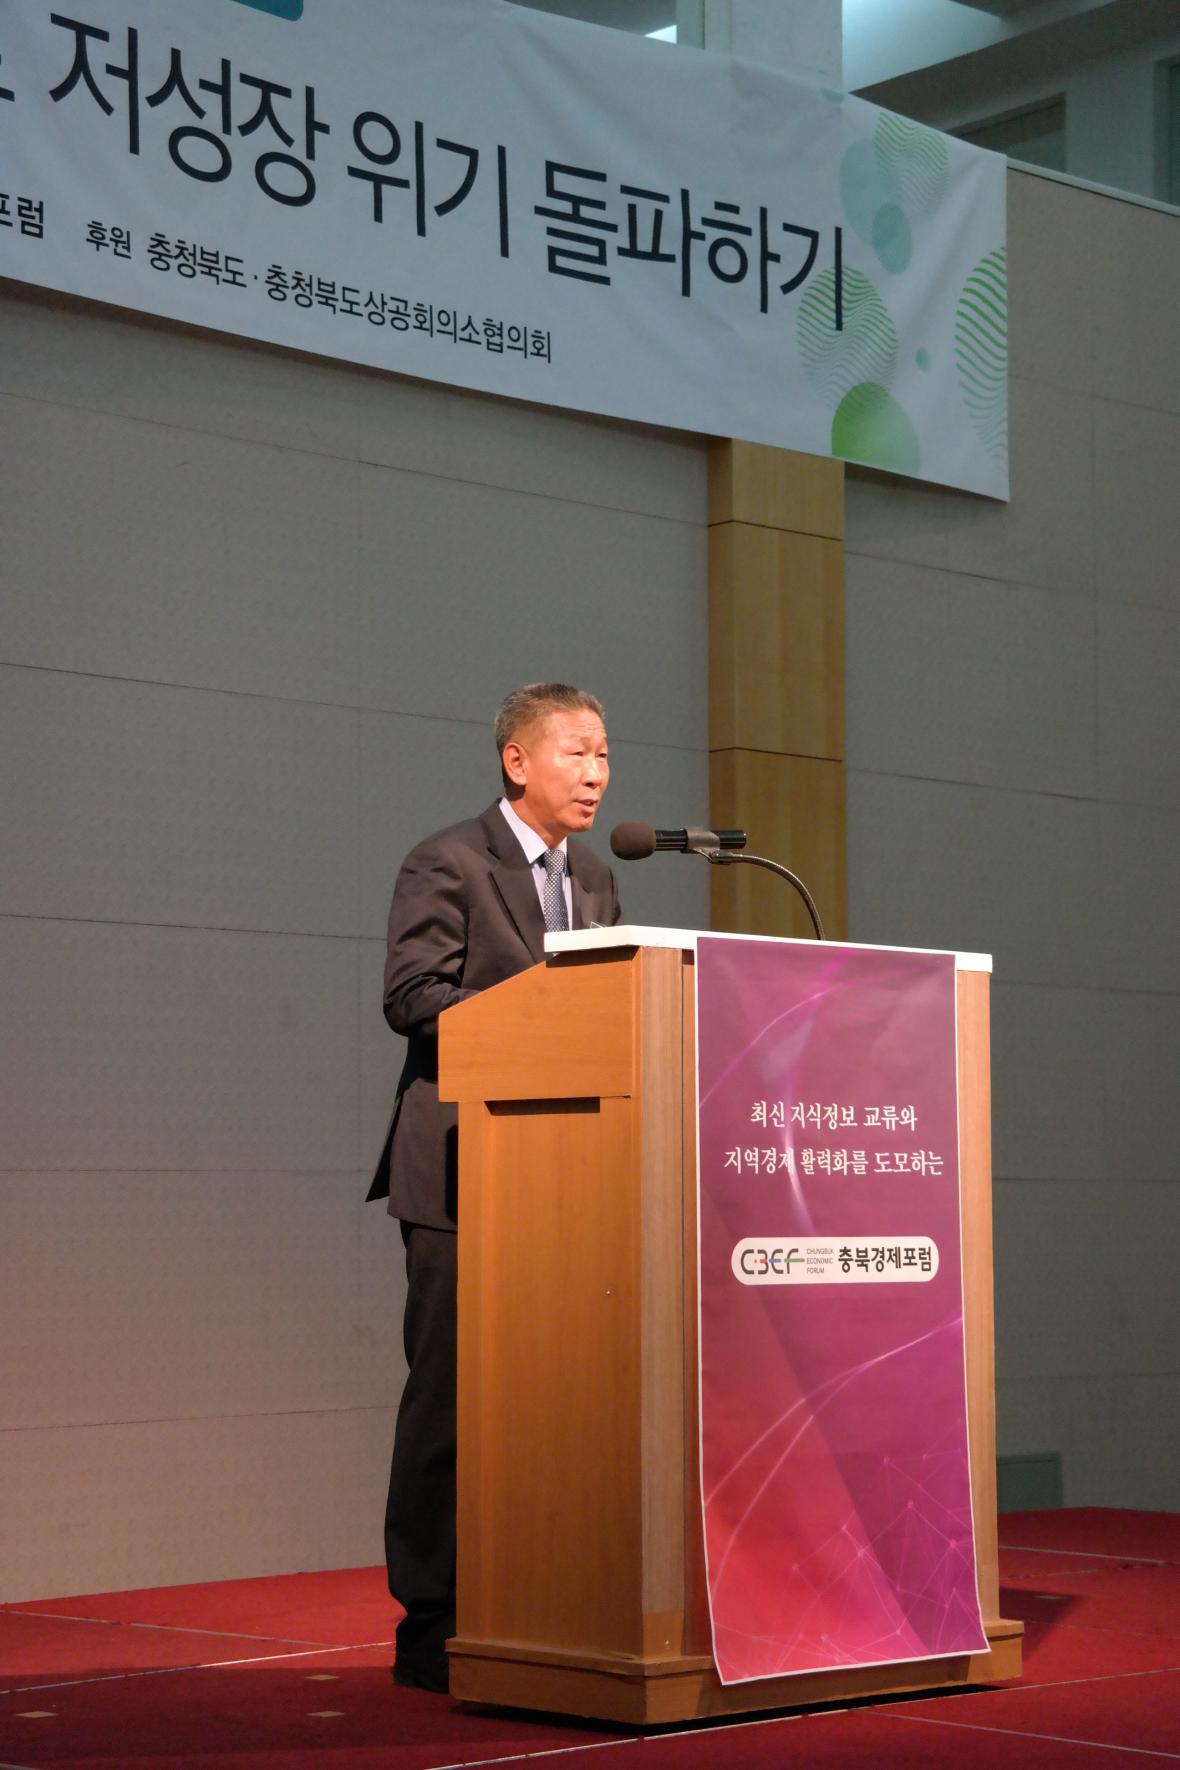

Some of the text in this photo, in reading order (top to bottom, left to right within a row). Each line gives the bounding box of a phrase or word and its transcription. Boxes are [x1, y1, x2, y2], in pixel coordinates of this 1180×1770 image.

[49, 13, 843, 331] 저성장 위기 돌파하기
[86, 221, 131, 259] 후원
[751, 1101, 918, 1131] 최신 지식정보 교류와
[724, 1147, 943, 1176] 지역경제 활력화를 도모하는
[806, 1257, 833, 1265] ECONOMIC
[838, 1246, 932, 1273] 충북경제포럼
